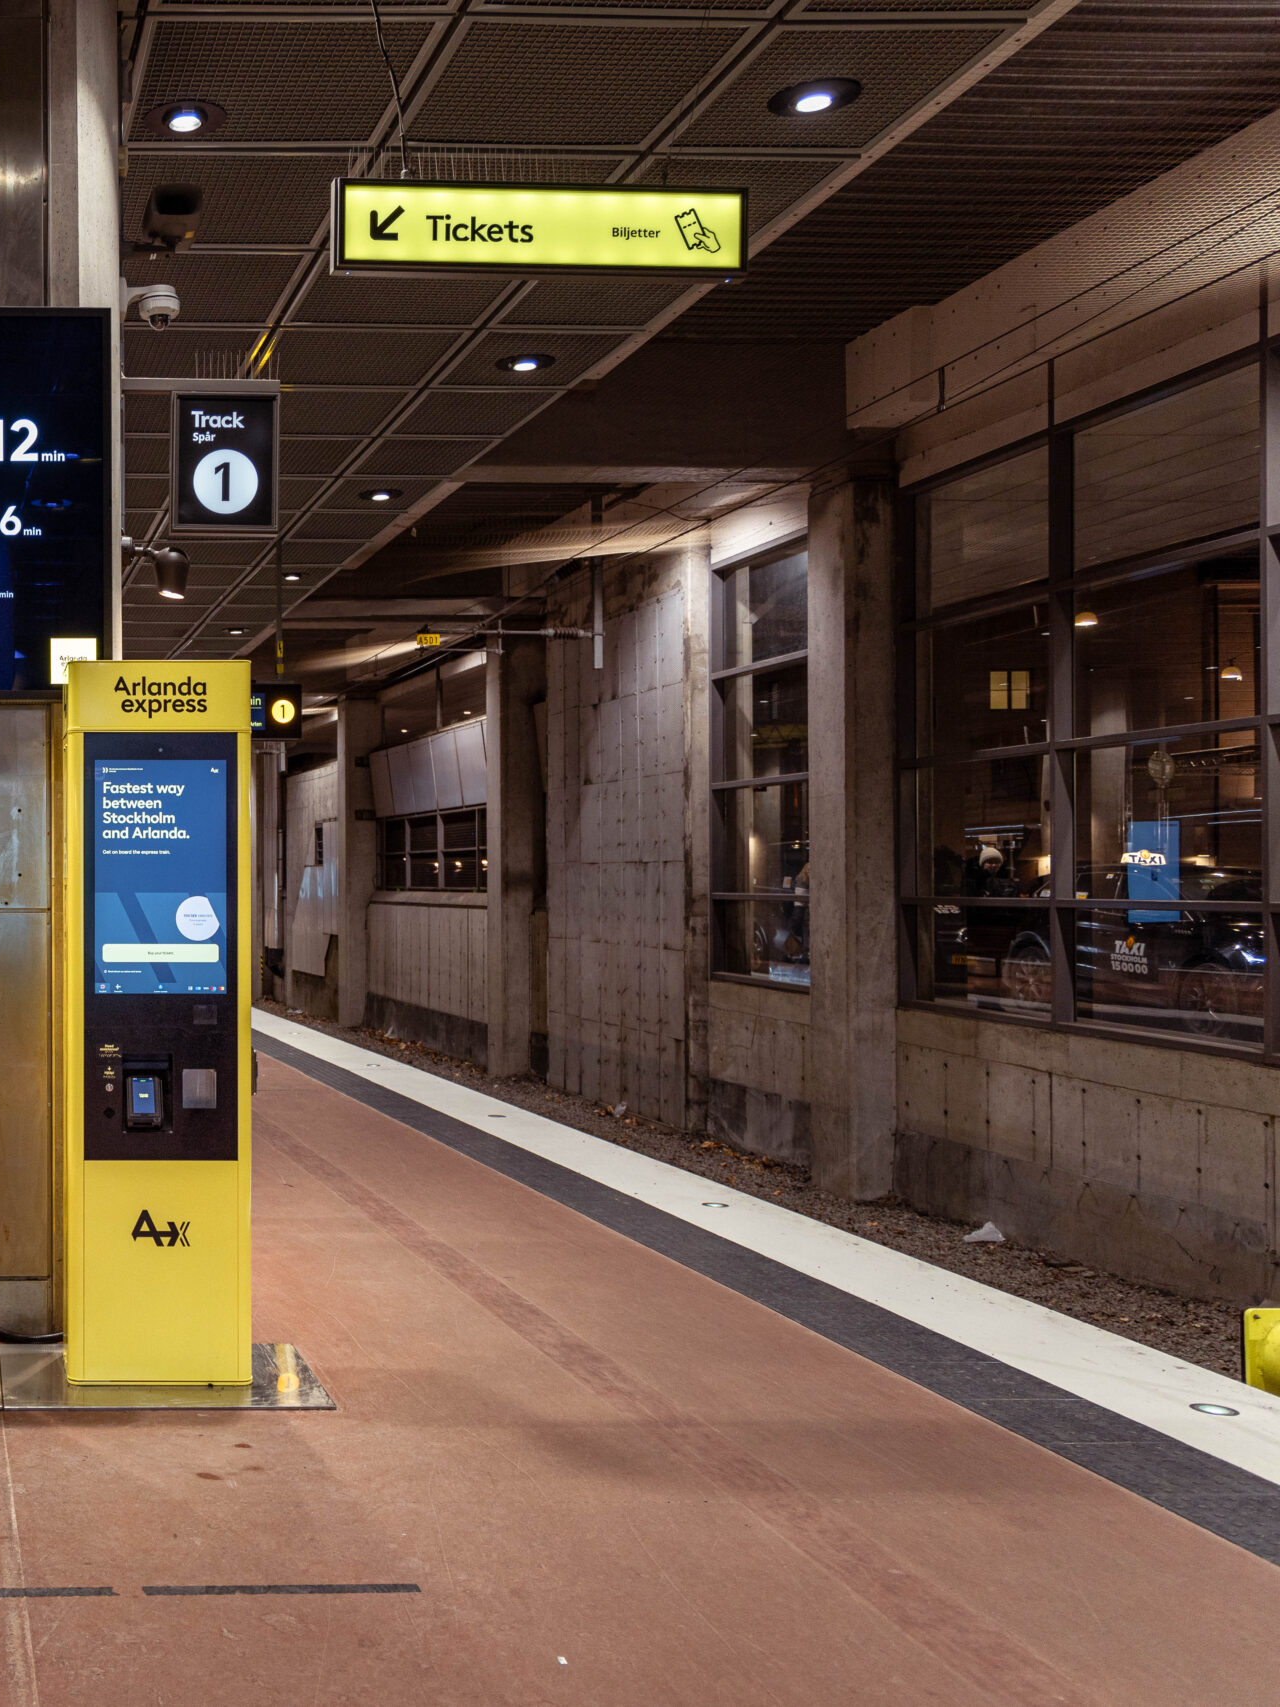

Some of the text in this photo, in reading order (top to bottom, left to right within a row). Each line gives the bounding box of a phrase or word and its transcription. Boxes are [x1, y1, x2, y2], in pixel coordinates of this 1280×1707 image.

[426, 215, 533, 243] Tickets
[612, 226, 661, 241] Biljetter
[191, 410, 244, 429] Track
[192, 430, 217, 444] Spår
[41, 450, 66, 462] min
[215, 462, 230, 502] 1
[23, 526, 42, 536] min
[0, 590, 14, 599] min
[114, 676, 207, 696] Arlanda
[121, 699, 208, 718] express
[103, 781, 185, 796] Fastest way
[102, 796, 162, 809] between
[102, 811, 176, 824] Stockholm
[102, 826, 190, 839] and Arlanda.
[1129, 854, 1162, 864] TAXI
[1114, 940, 1145, 956] TAXI
[1111, 953, 1148, 964] STOCKHOLM
